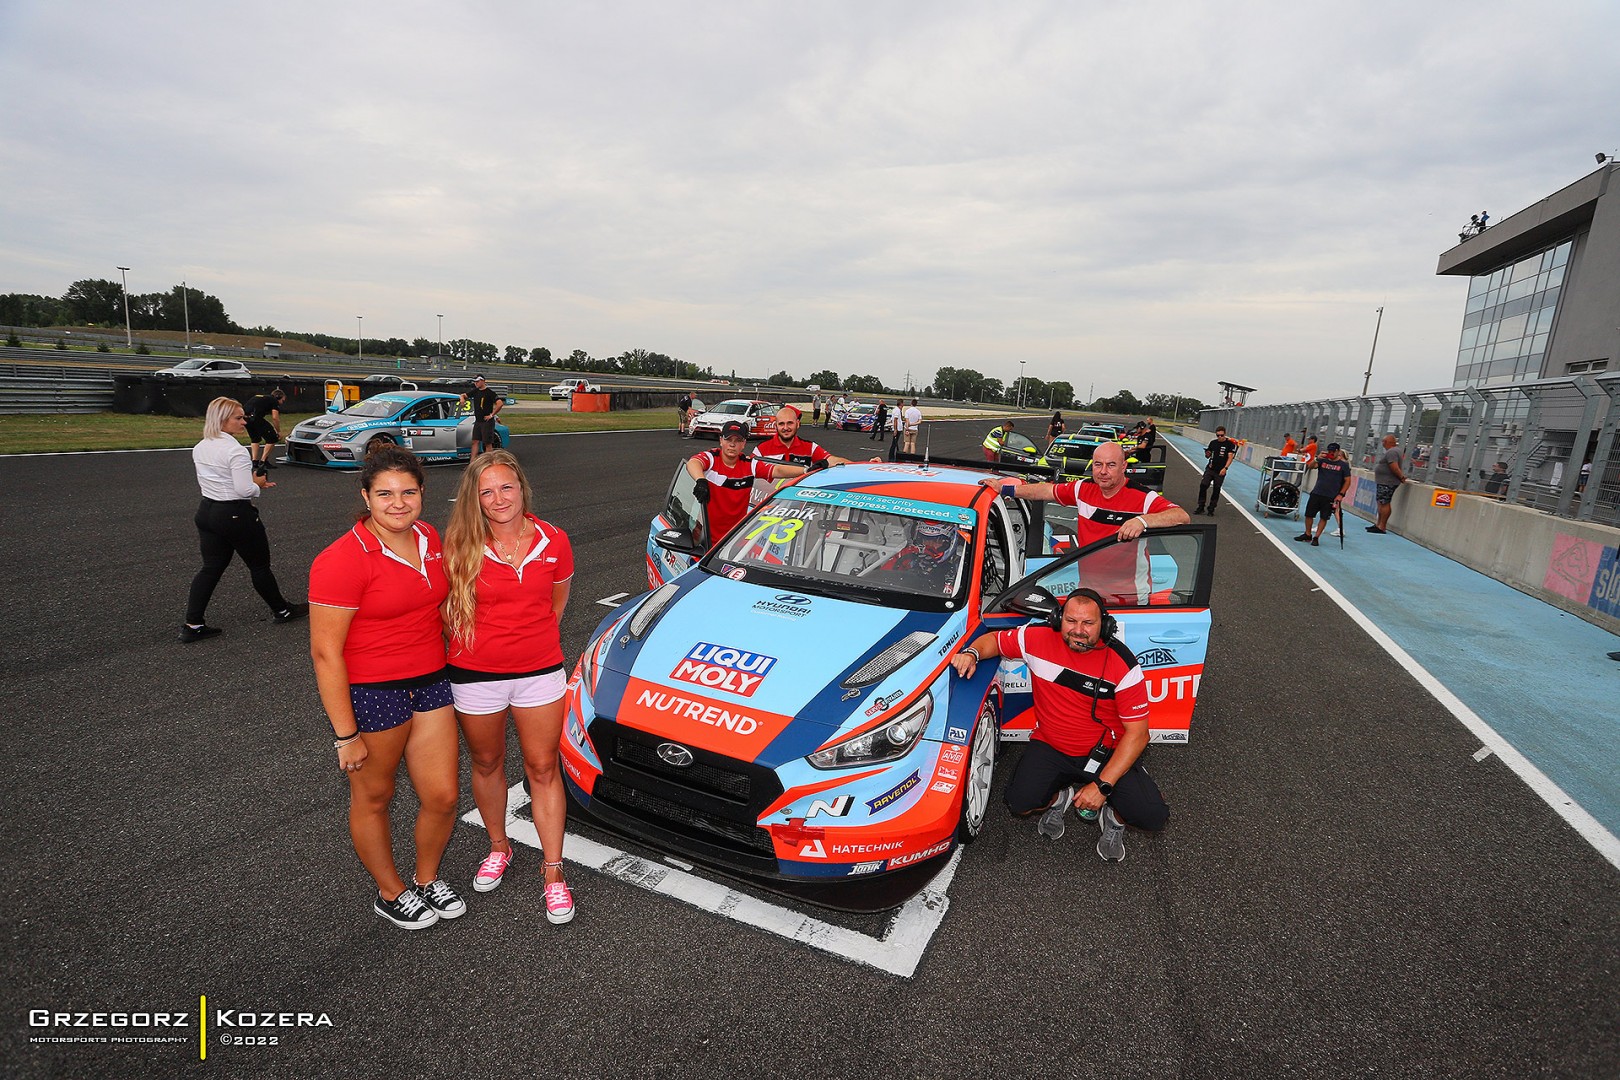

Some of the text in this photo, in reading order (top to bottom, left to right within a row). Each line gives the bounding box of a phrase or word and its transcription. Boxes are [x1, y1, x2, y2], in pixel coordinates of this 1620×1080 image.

[840, 498, 890, 511] Progress.
[892, 506, 954, 519] Protected.
[845, 494, 914, 507] Digital Security
[744, 516, 805, 544] 73
[1046, 581, 1076, 595] PRES
[751, 604, 807, 618] MOTORSPORT
[756, 600, 812, 614] HYUNDAI
[690, 644, 773, 674] LIQUI
[673, 661, 762, 694] MOLY
[1145, 674, 1201, 703] UT
[636, 689, 757, 735] NUTREND
[873, 777, 917, 809] RAVENOL
[832, 840, 904, 854] HATECHNIK
[889, 841, 951, 867] KUMHO
